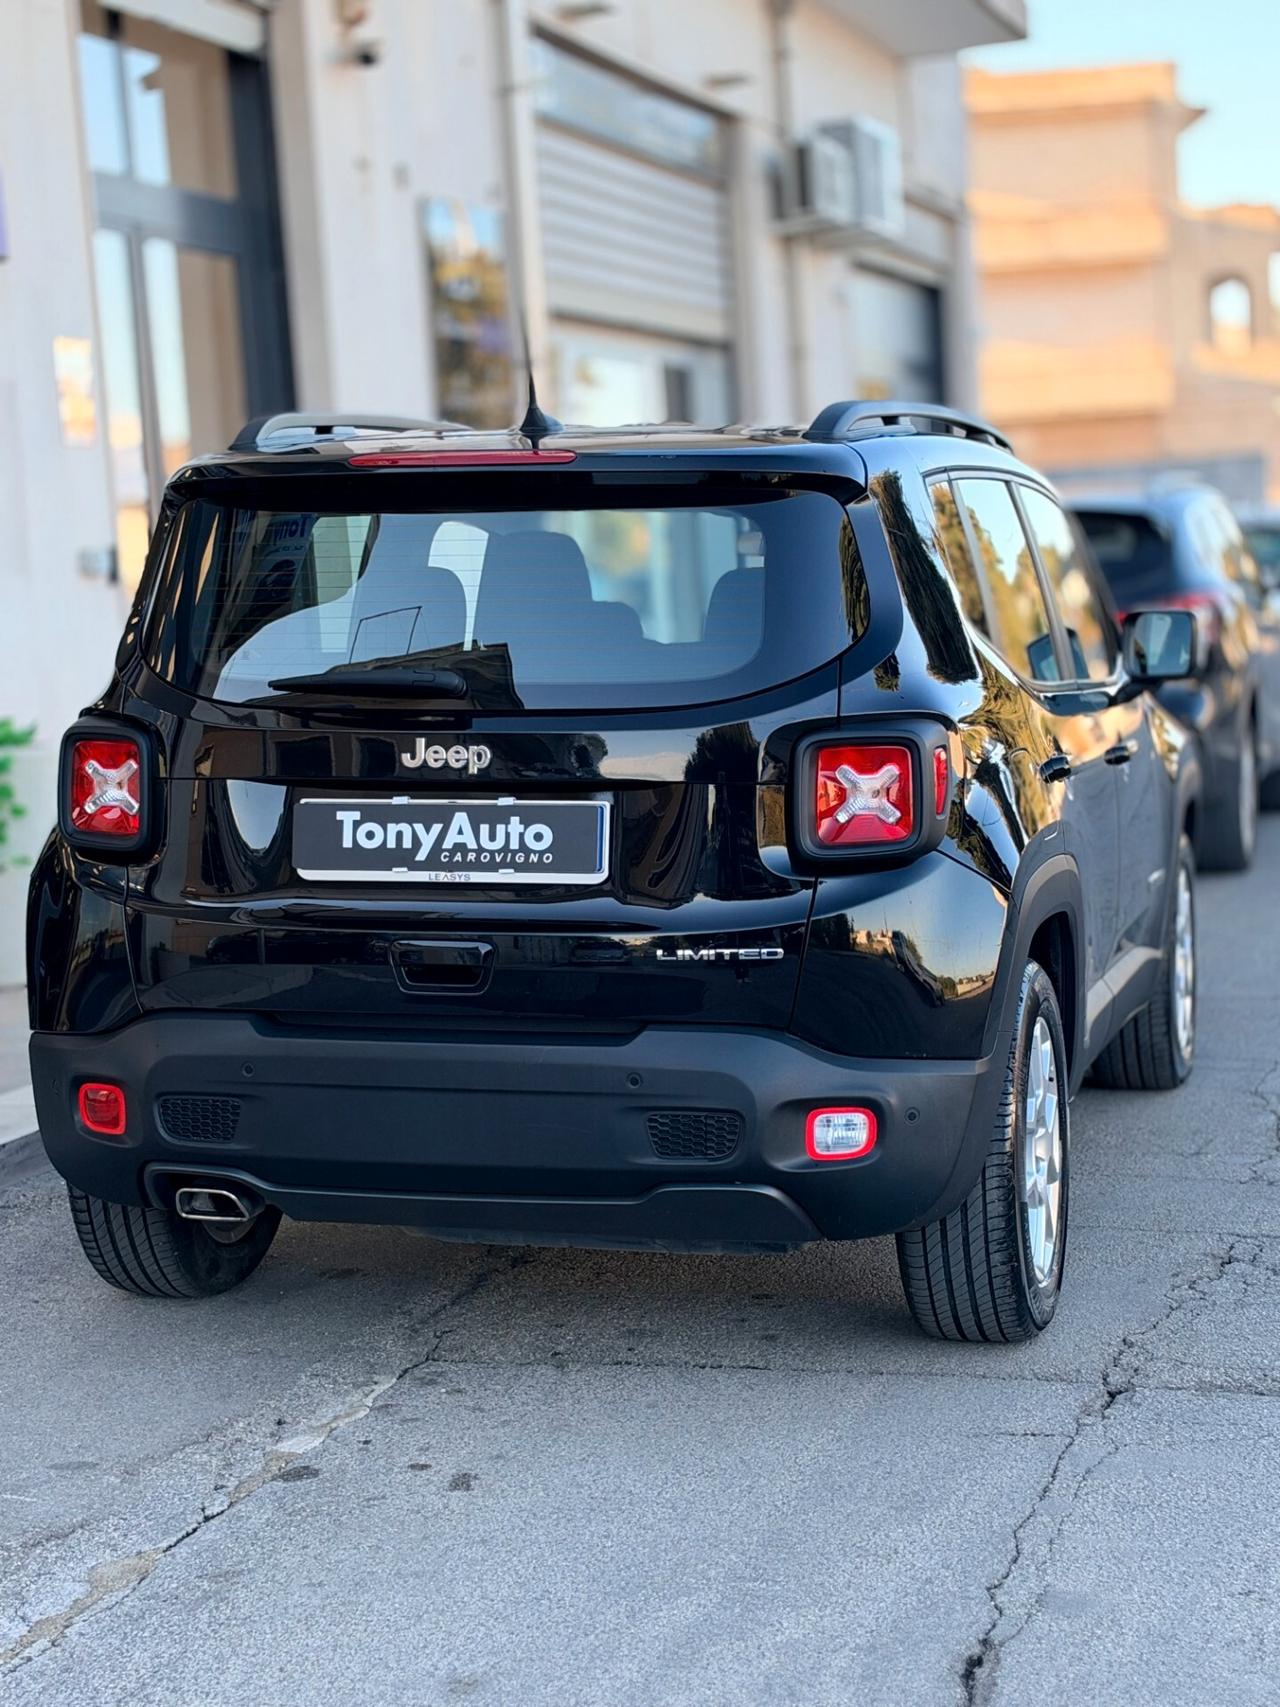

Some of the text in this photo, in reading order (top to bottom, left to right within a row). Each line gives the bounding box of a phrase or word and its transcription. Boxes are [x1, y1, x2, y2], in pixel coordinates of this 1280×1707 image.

[401, 737, 491, 774] Jeep
[336, 810, 554, 862] TonyAuto
[440, 851, 553, 863] CAROVIGNO
[428, 872, 471, 881] LEASYS
[656, 948, 785, 961] LIMITED
